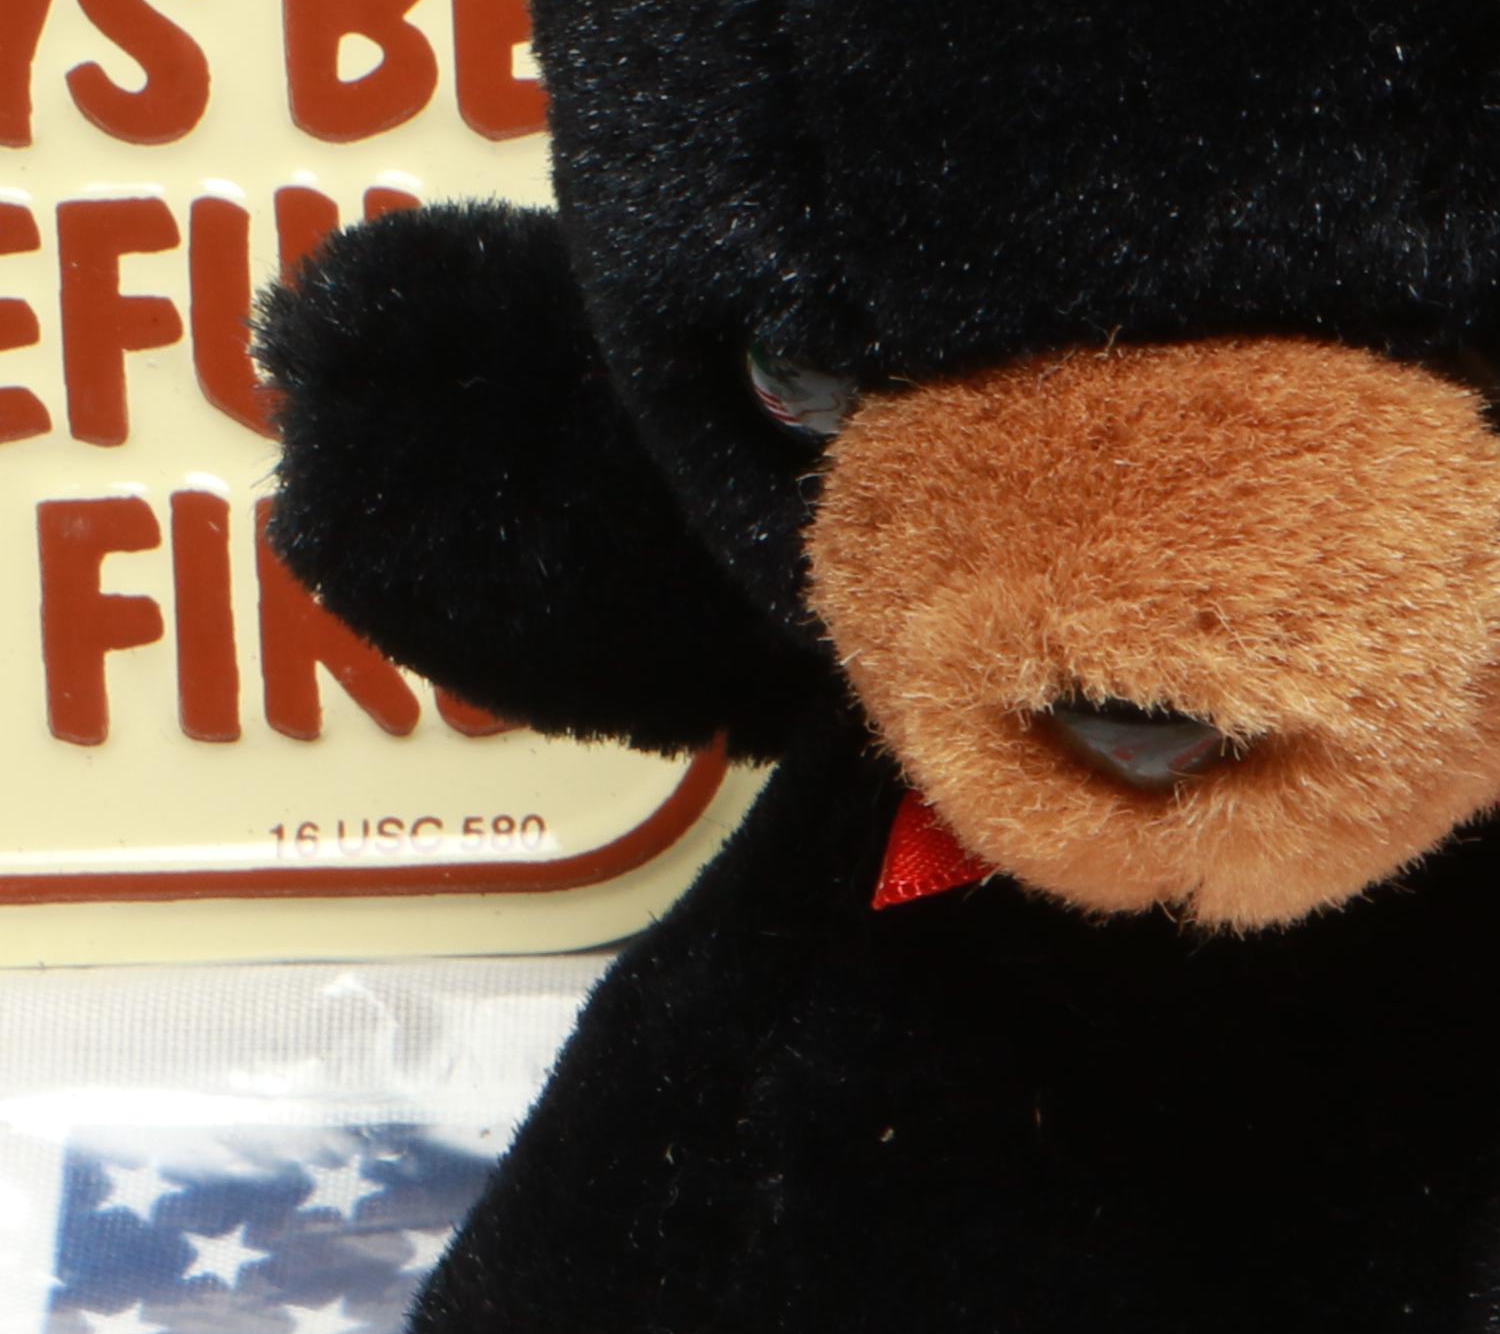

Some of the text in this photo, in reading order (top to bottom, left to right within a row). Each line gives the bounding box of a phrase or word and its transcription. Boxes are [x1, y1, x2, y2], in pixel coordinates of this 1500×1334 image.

[269, 814, 547, 859] 16 USC 580
